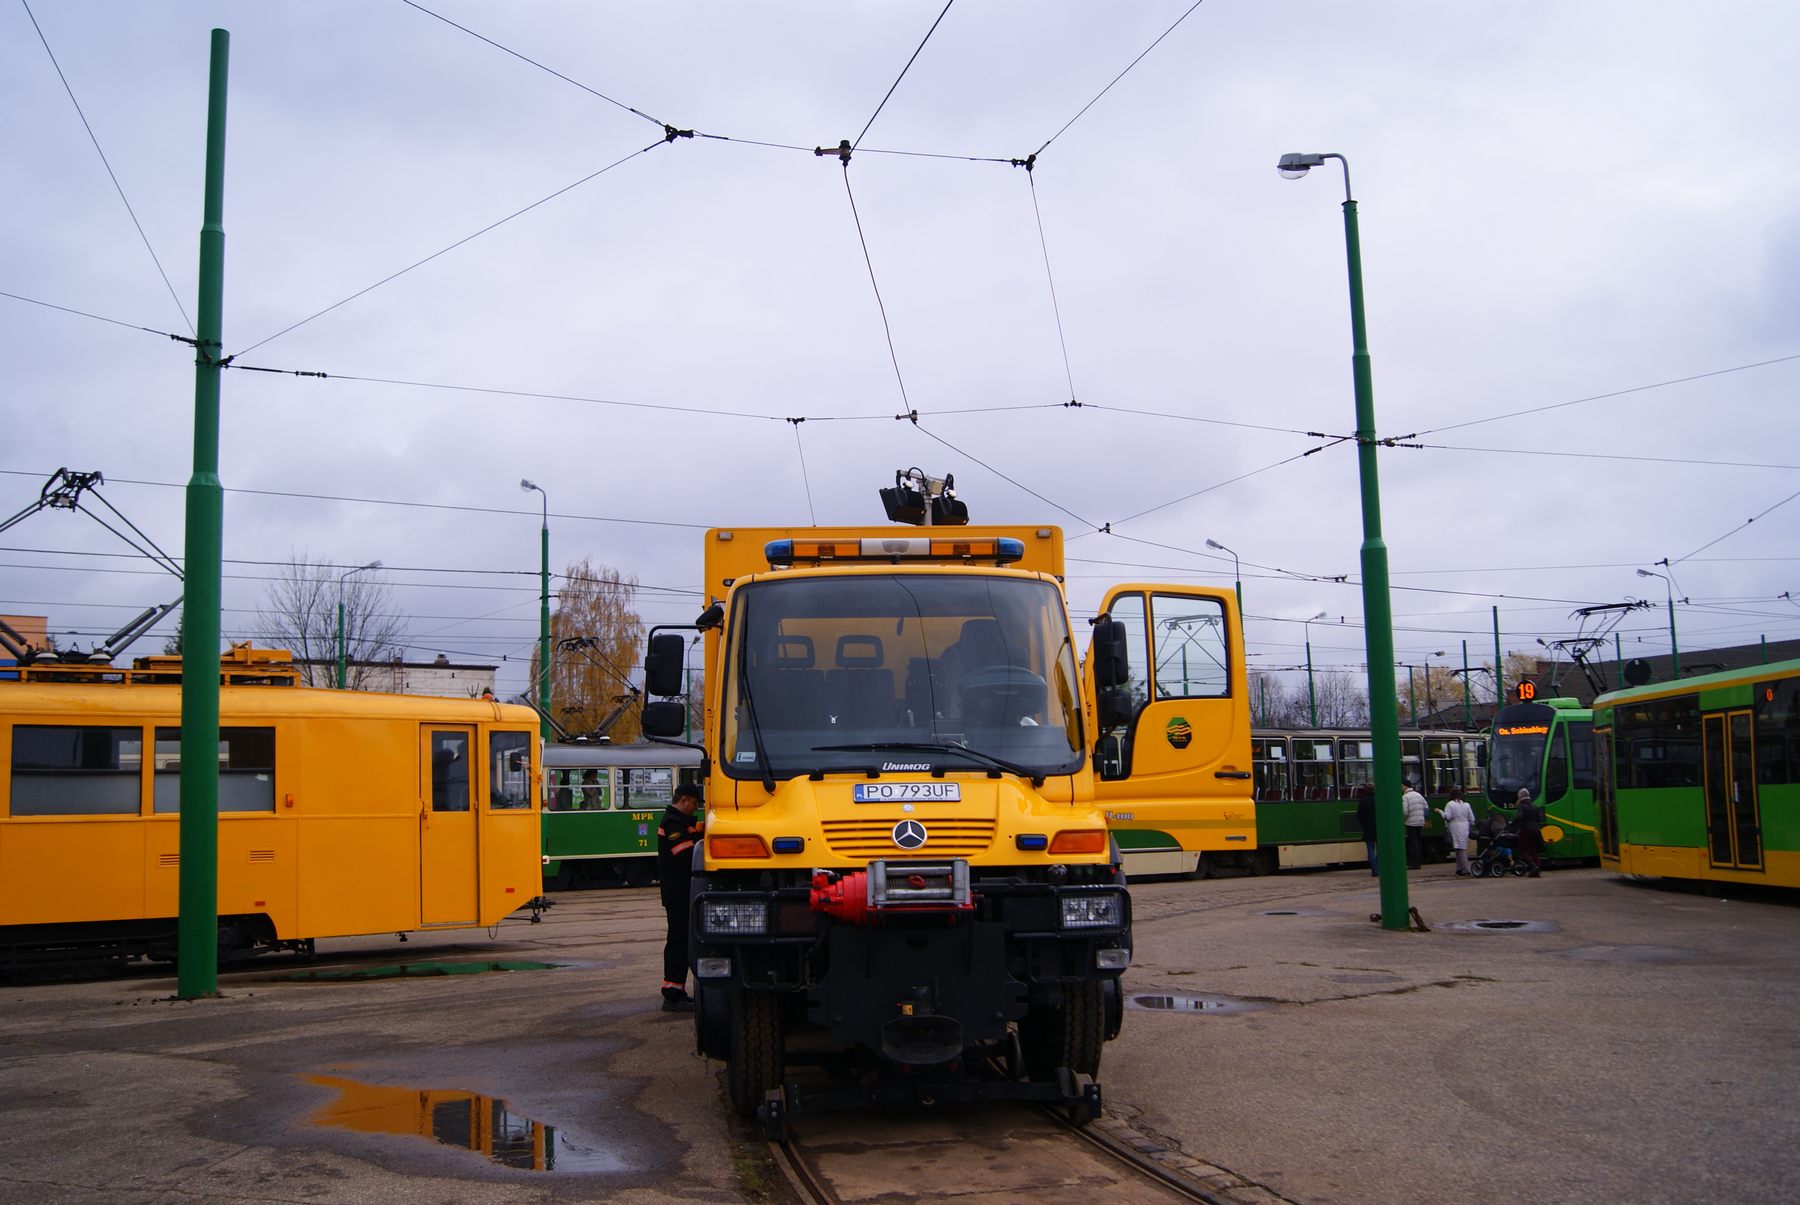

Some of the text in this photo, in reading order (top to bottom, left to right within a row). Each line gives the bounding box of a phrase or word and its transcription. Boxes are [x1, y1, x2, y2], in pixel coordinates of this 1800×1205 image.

[1519, 684, 1534, 699] 19
[866, 785, 955, 798] PO 793UF
[632, 813, 654, 821] MPK
[638, 839, 649, 847] 71
